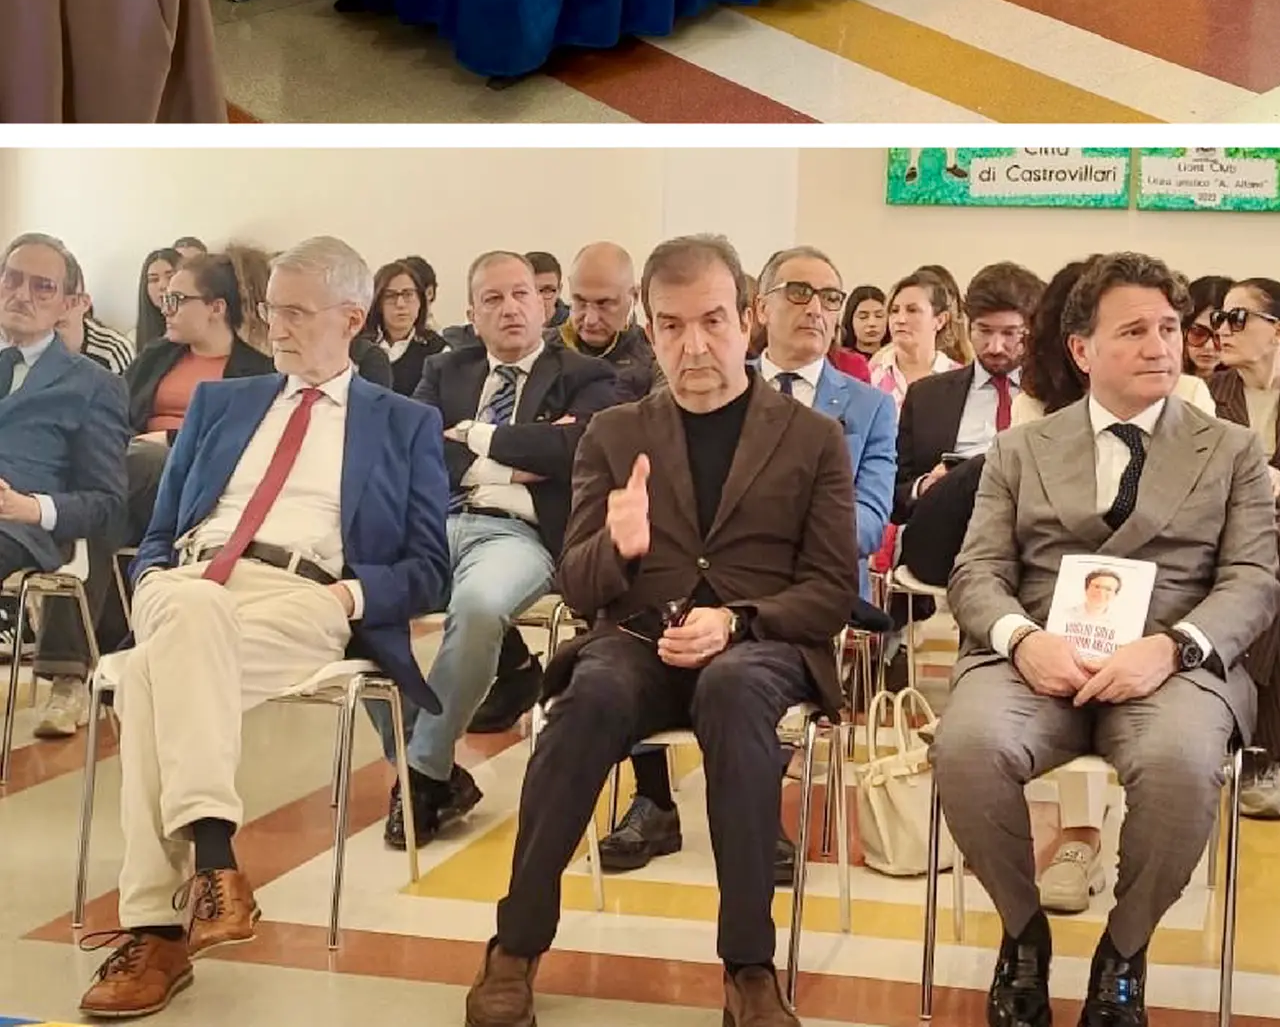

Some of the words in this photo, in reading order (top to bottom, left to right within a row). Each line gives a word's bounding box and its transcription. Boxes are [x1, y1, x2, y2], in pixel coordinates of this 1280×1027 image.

[979, 166, 996, 182] di
[1005, 164, 1117, 183] Castrovillari
[1210, 162, 1237, 174] Club
